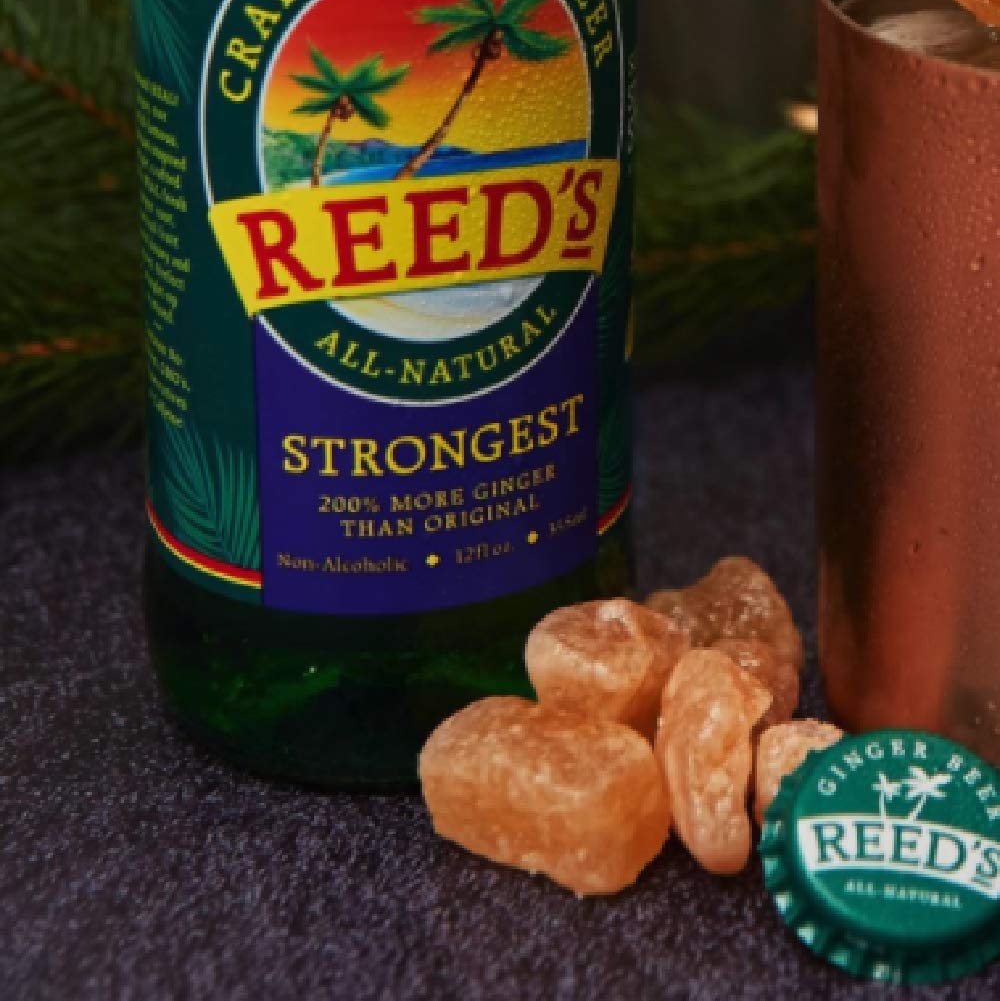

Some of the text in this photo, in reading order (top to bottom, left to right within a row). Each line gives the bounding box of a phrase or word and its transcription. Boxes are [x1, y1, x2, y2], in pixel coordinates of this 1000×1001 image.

[236, 168, 603, 300] REED'S
[313, 303, 558, 385] ALL-NATURAL
[281, 393, 585, 477] STRONGEST
[318, 463, 557, 514] 200% MORE GINGER
[339, 493, 541, 538] THAN ORIGINAL
[817, 738, 927, 796] GINGER
